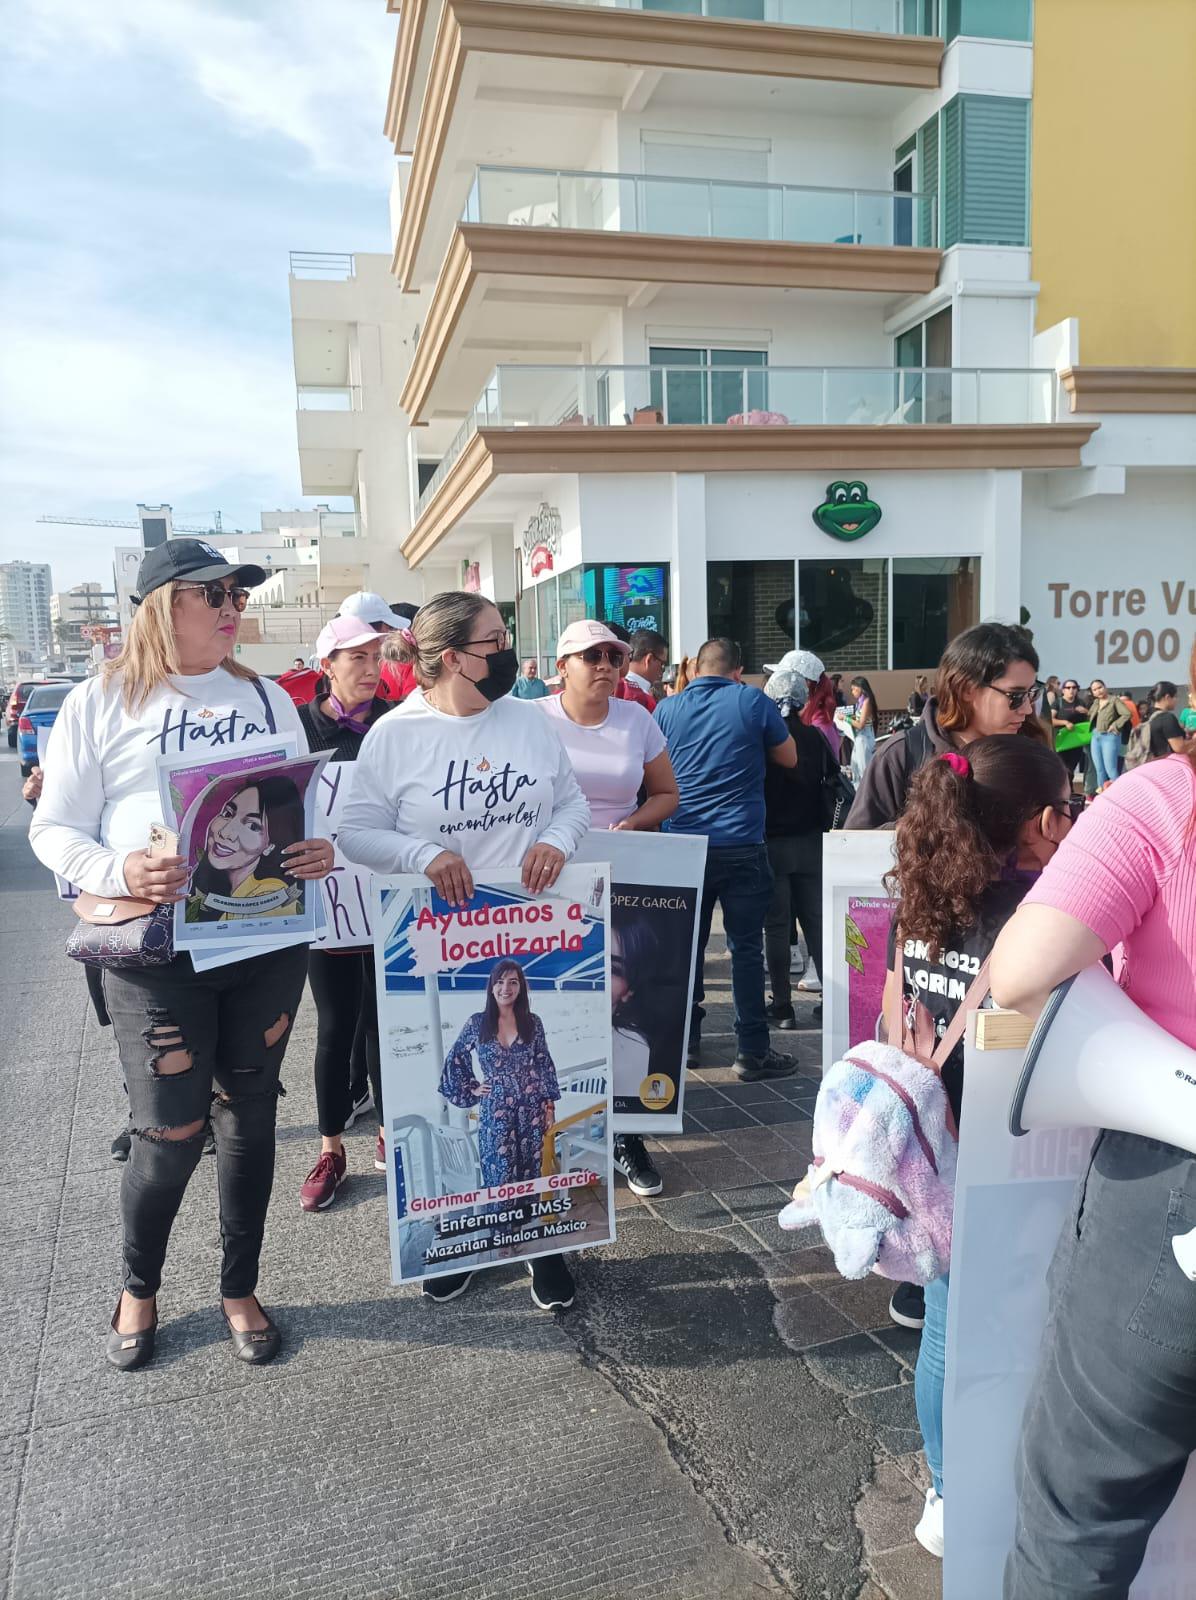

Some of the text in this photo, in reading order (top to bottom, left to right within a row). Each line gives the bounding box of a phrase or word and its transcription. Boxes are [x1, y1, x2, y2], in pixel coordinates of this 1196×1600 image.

[1048, 583, 1146, 618] Torre
[1094, 628, 1180, 665] 1200
[147, 709, 265, 754] Hasta
[432, 760, 537, 811] Hasta
[440, 802, 541, 834] encontrarlos!
[417, 900, 583, 934] Ayúdanos a
[642, 895, 687, 910] GARCÍA
[441, 930, 584, 962] localizarla
[411, 1169, 597, 1212] Glorimar López García
[440, 1198, 573, 1233] Enfermera IMSS
[425, 1220, 587, 1259] Mazatlán Sinaloa México
